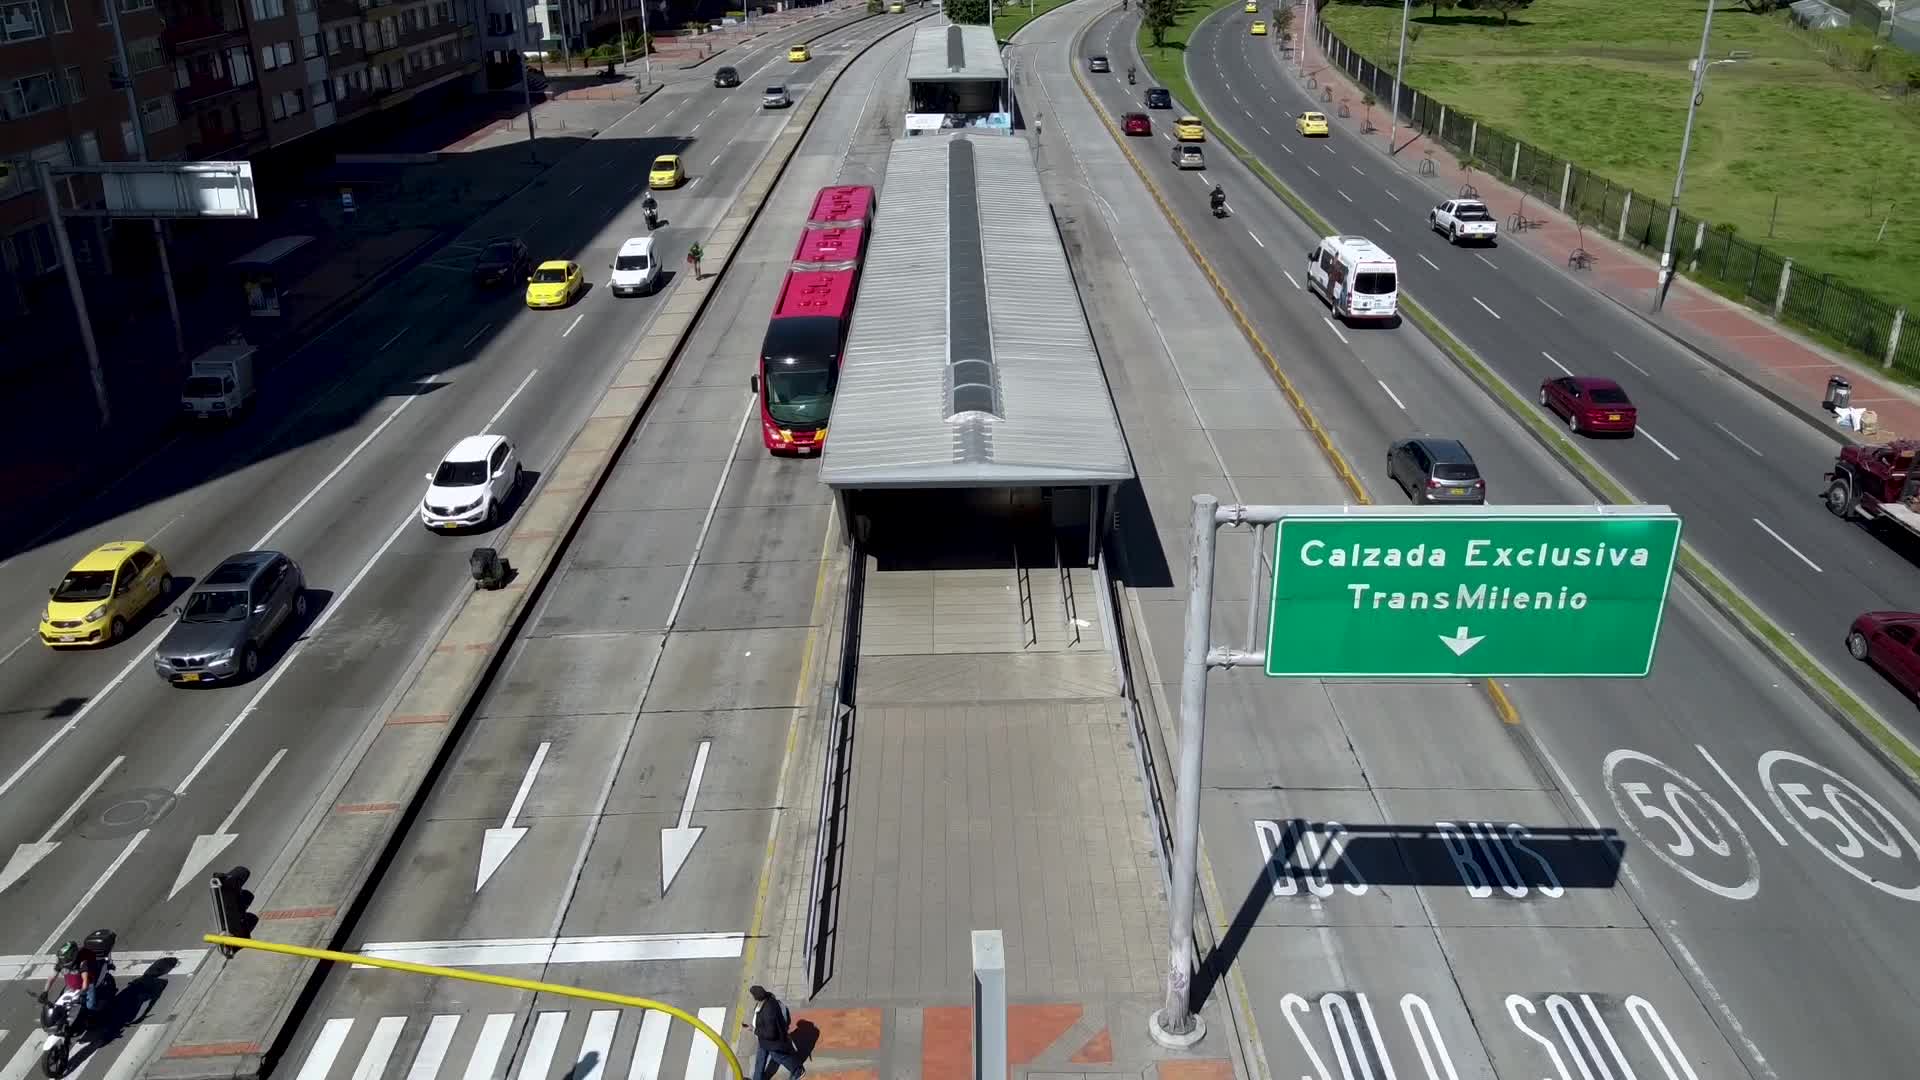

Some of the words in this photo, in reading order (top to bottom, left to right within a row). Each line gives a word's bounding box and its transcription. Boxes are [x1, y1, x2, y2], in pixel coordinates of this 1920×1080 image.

[1299, 539, 1446, 567] Calzada
[1465, 539, 1650, 567] Exclusiva
[1347, 583, 1588, 610] TransMilenio
[1620, 782, 1730, 857] 50
[1778, 783, 1902, 858] 50
[1254, 820, 1369, 897] BUS
[1435, 822, 1565, 898] BUS
